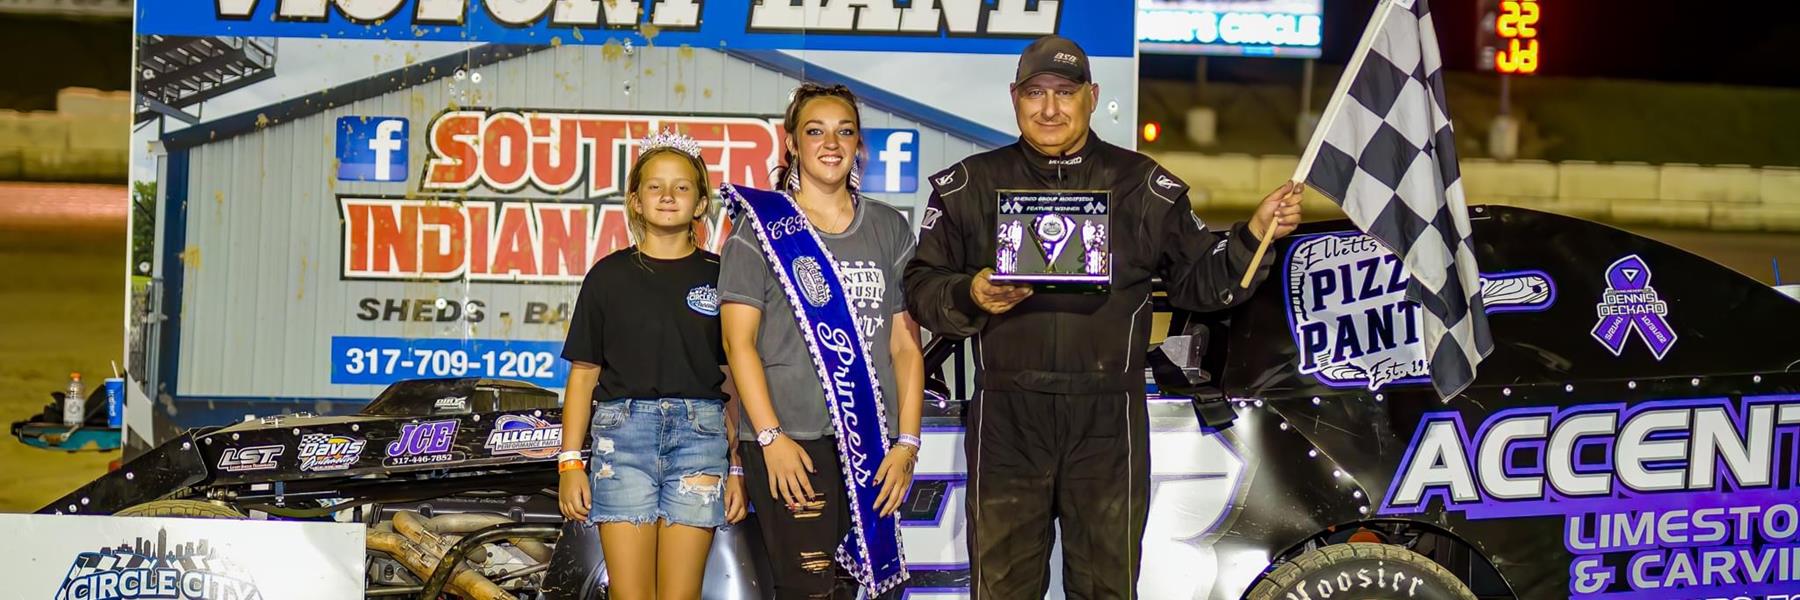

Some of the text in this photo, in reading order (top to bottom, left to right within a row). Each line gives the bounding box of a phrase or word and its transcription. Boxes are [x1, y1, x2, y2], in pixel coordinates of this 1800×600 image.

[1219, 12, 1321, 46] CIRCLE
[428, 112, 788, 196] SOUTER
[848, 286, 883, 298] USIC
[1606, 293, 1655, 305] DENNIS
[357, 297, 486, 323] SHEDS
[1600, 303, 1665, 316] DECKARD
[345, 348, 554, 378] 317-709-1202
[817, 322, 871, 488] Princess
[387, 420, 458, 457] JCE
[490, 427, 563, 446] ALLGAIE
[220, 447, 281, 466] LST
[1392, 403, 1800, 505] ACCEN
[1569, 503, 1799, 550] LIMESTO
[68, 570, 262, 600] CIRCLE CITY
[1574, 547, 1800, 594] & CARVI
